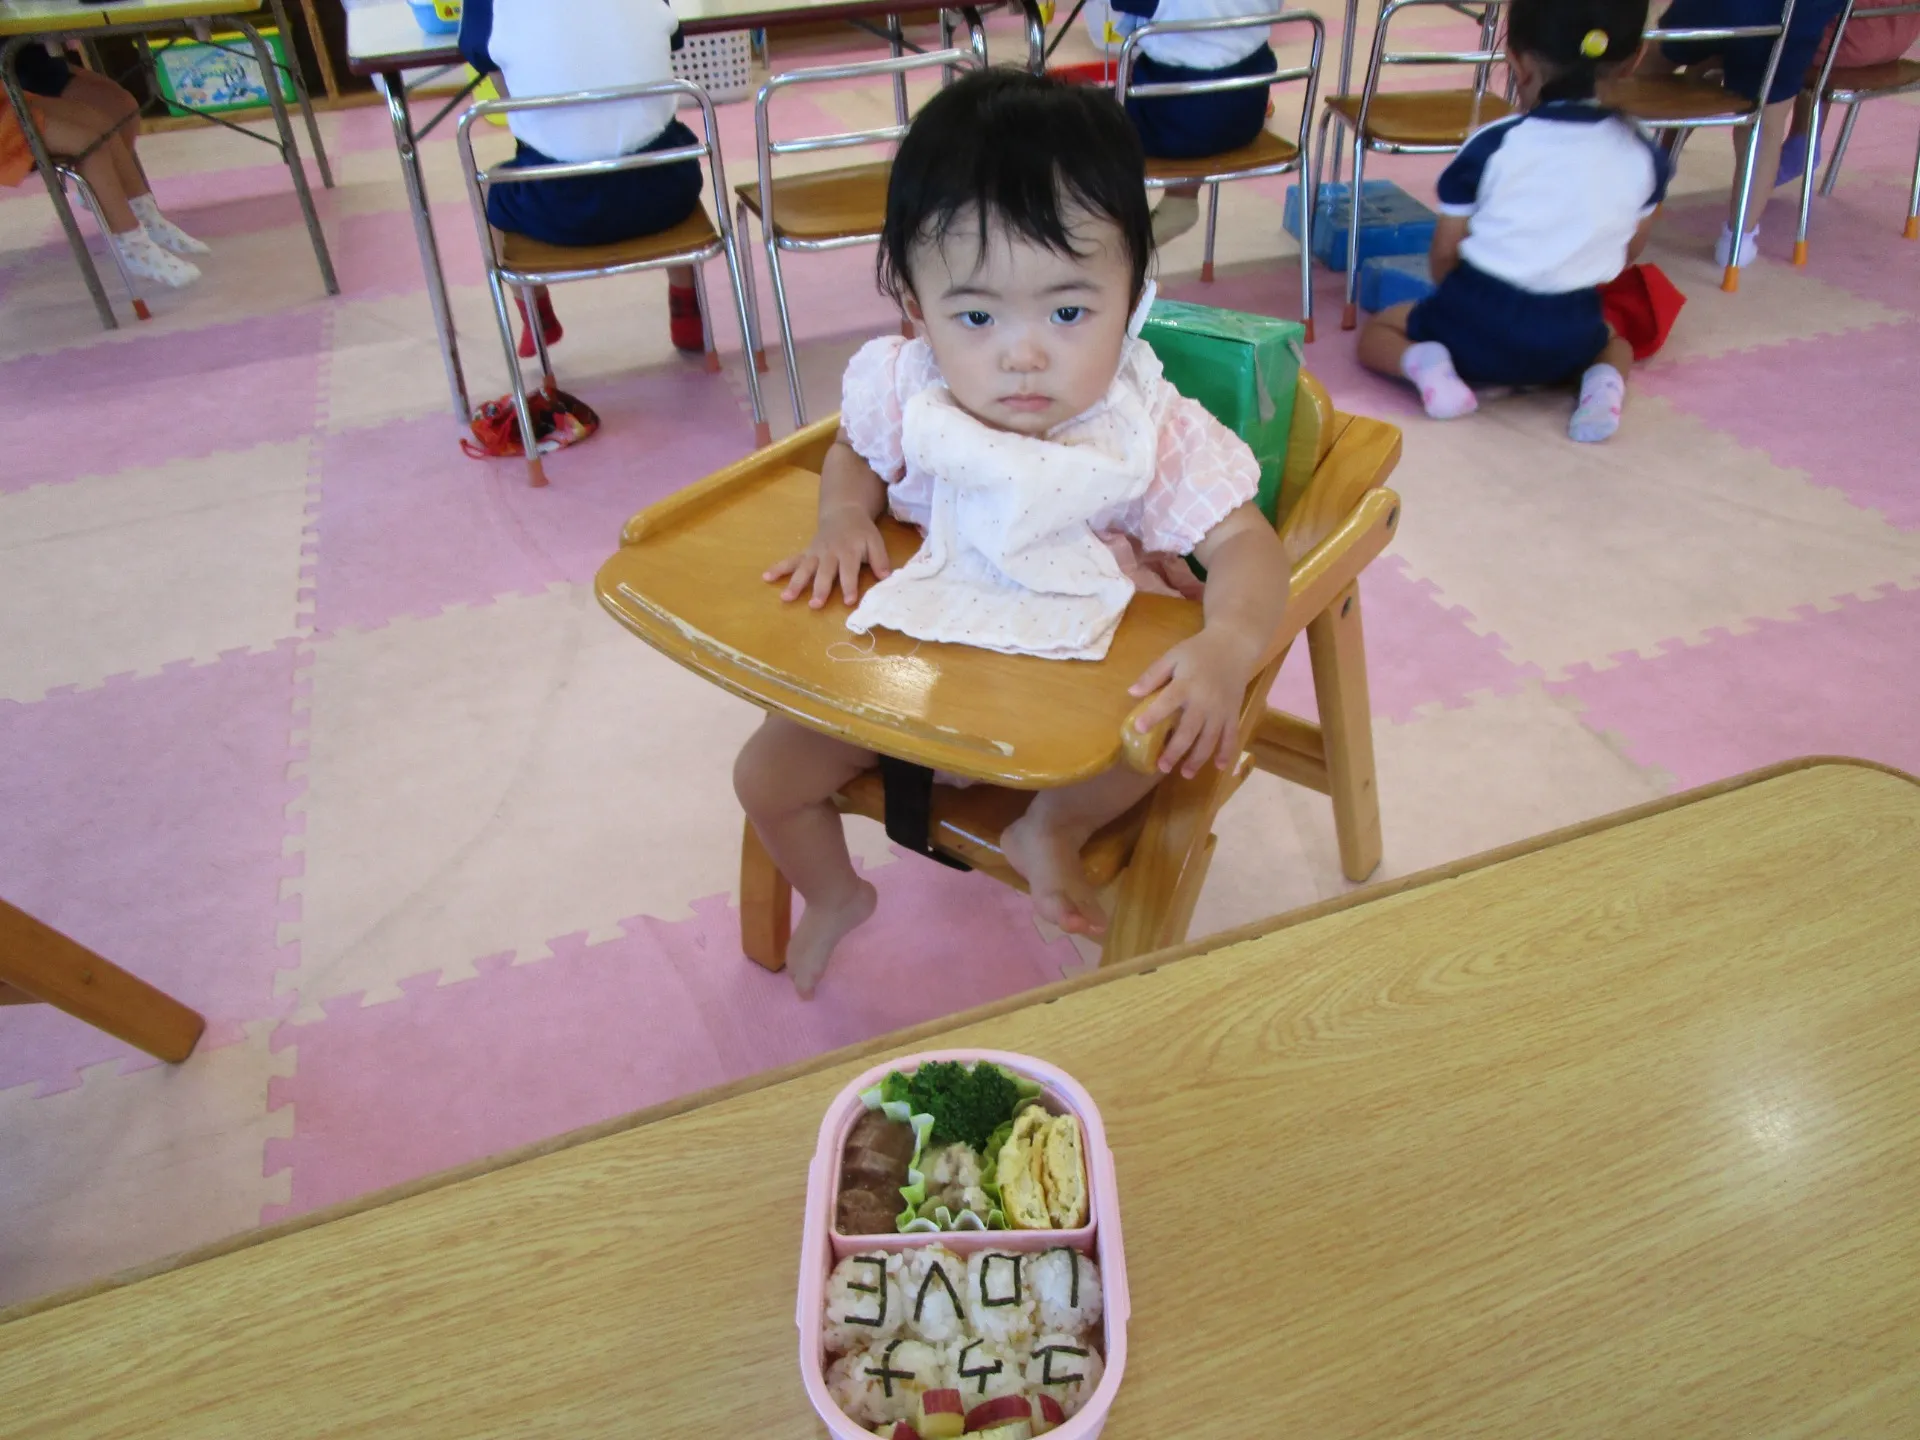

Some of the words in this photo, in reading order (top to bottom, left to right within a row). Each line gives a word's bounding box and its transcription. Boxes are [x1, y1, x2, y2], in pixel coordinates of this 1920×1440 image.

[844, 1246, 1079, 1327] LOVE
[864, 1338, 1090, 1398] ユウナ
